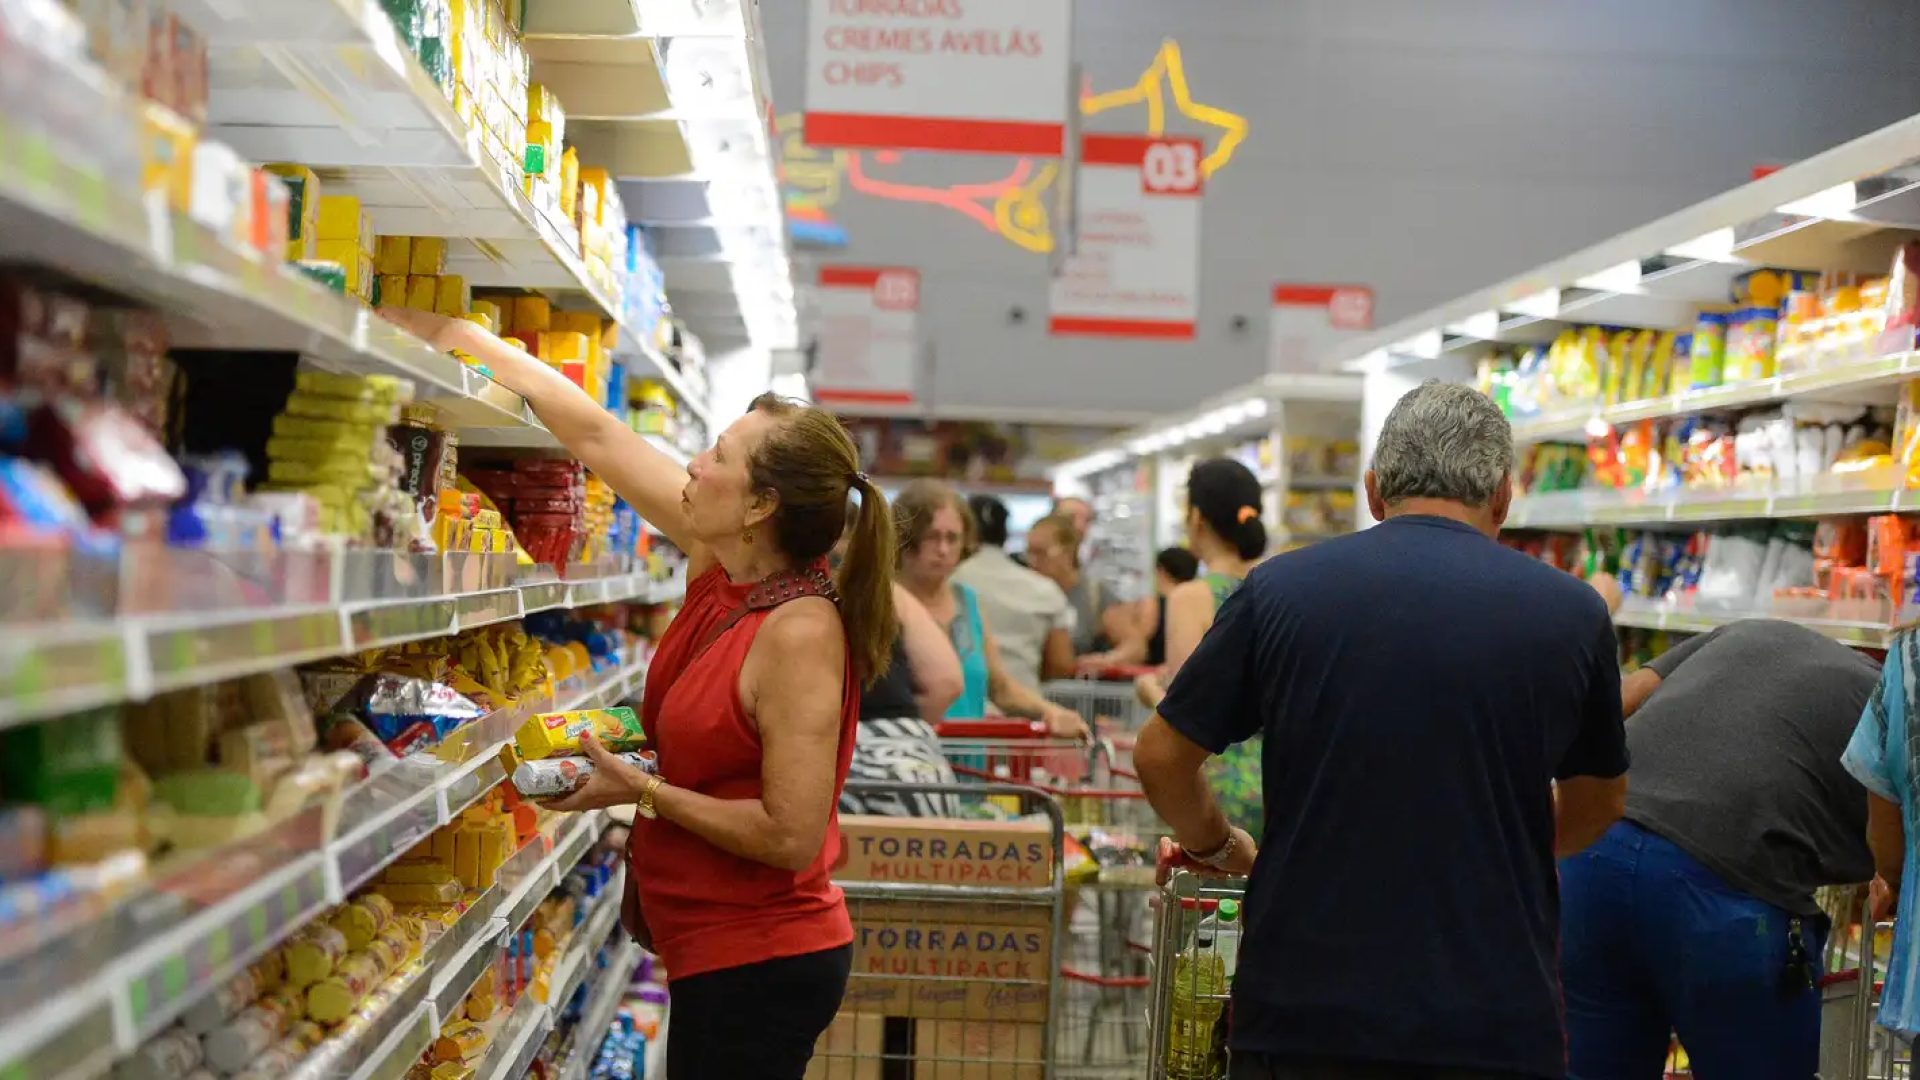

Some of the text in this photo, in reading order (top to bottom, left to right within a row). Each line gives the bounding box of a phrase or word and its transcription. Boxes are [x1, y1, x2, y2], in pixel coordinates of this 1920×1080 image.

[823, 27, 933, 54] CREMES
[822, 60, 905, 87] CHIPS
[1143, 141, 1199, 190] 03
[859, 836, 1043, 862] TORRADAS
[870, 861, 1034, 881] MULTIPACK
[860, 928, 1041, 953] TORRADAS
[869, 957, 1031, 978] MULTIPACK
